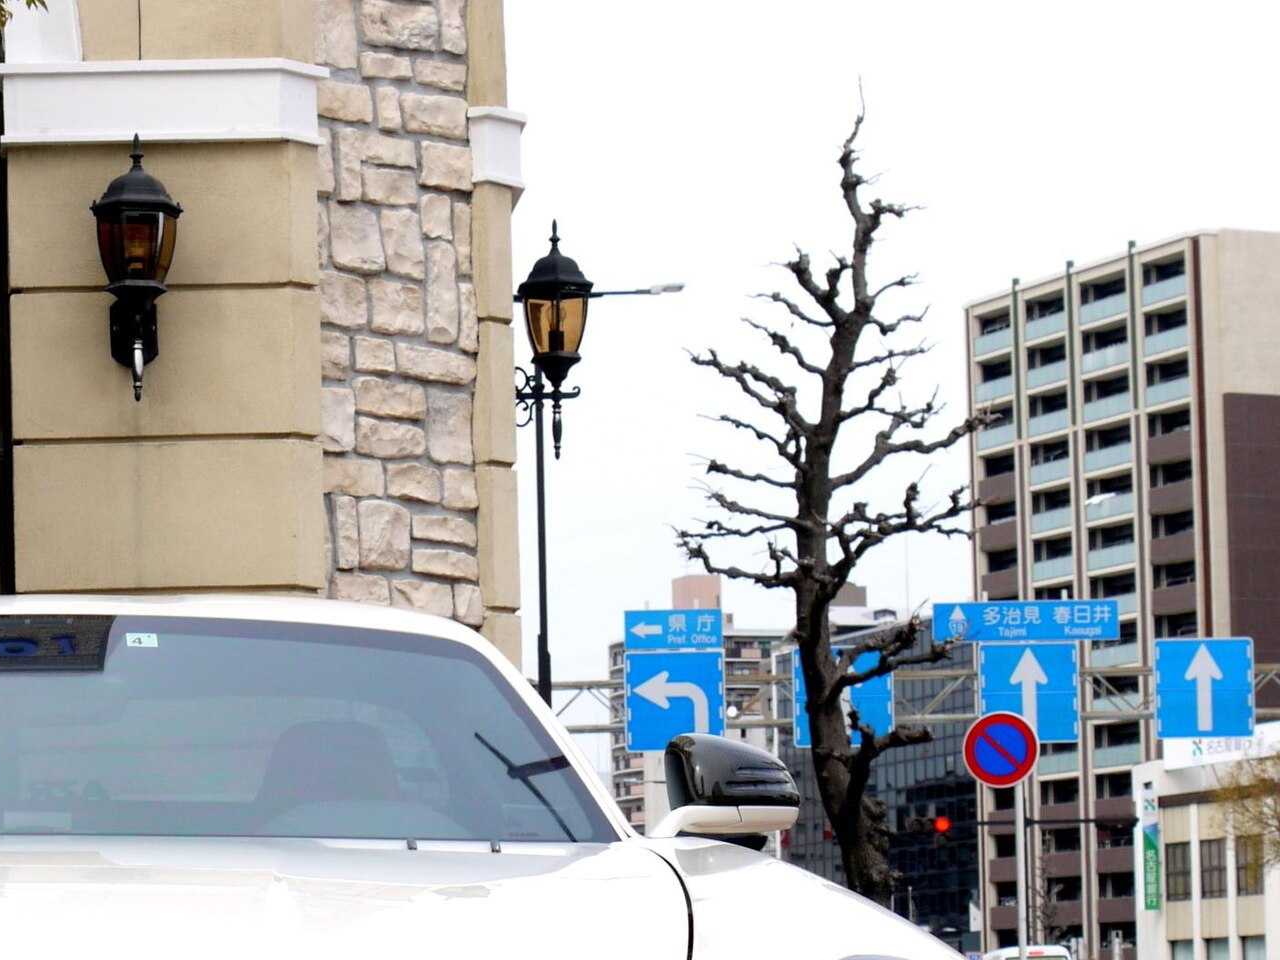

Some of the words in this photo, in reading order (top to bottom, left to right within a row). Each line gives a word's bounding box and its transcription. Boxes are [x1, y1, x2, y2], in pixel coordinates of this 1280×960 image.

[668, 613, 715, 633] 県庁
[982, 606, 1042, 626] 多治見
[1053, 604, 1113, 624] 春日井
[691, 633, 718, 644] Office
[997, 626, 1028, 639] Tajimi
[1063, 625, 1103, 638] Kasugai
